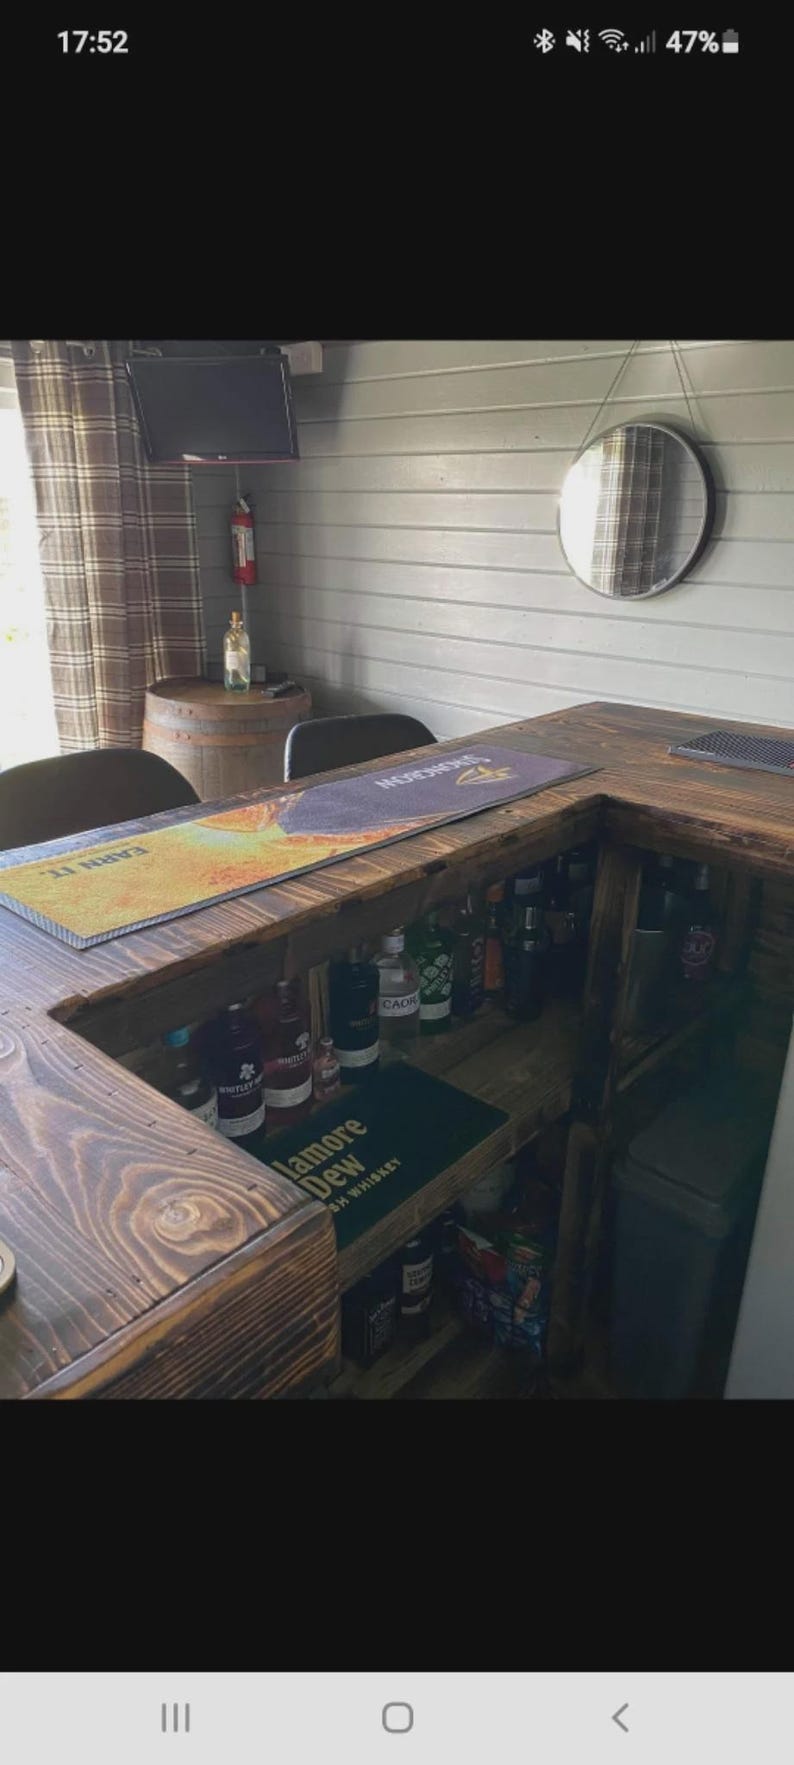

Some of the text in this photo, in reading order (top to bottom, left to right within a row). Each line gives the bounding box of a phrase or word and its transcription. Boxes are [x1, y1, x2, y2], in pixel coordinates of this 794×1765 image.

[78, 846, 150, 870] EARN
[297, 1153, 366, 1200] Dew
[347, 1156, 402, 1198] WHISKEY
